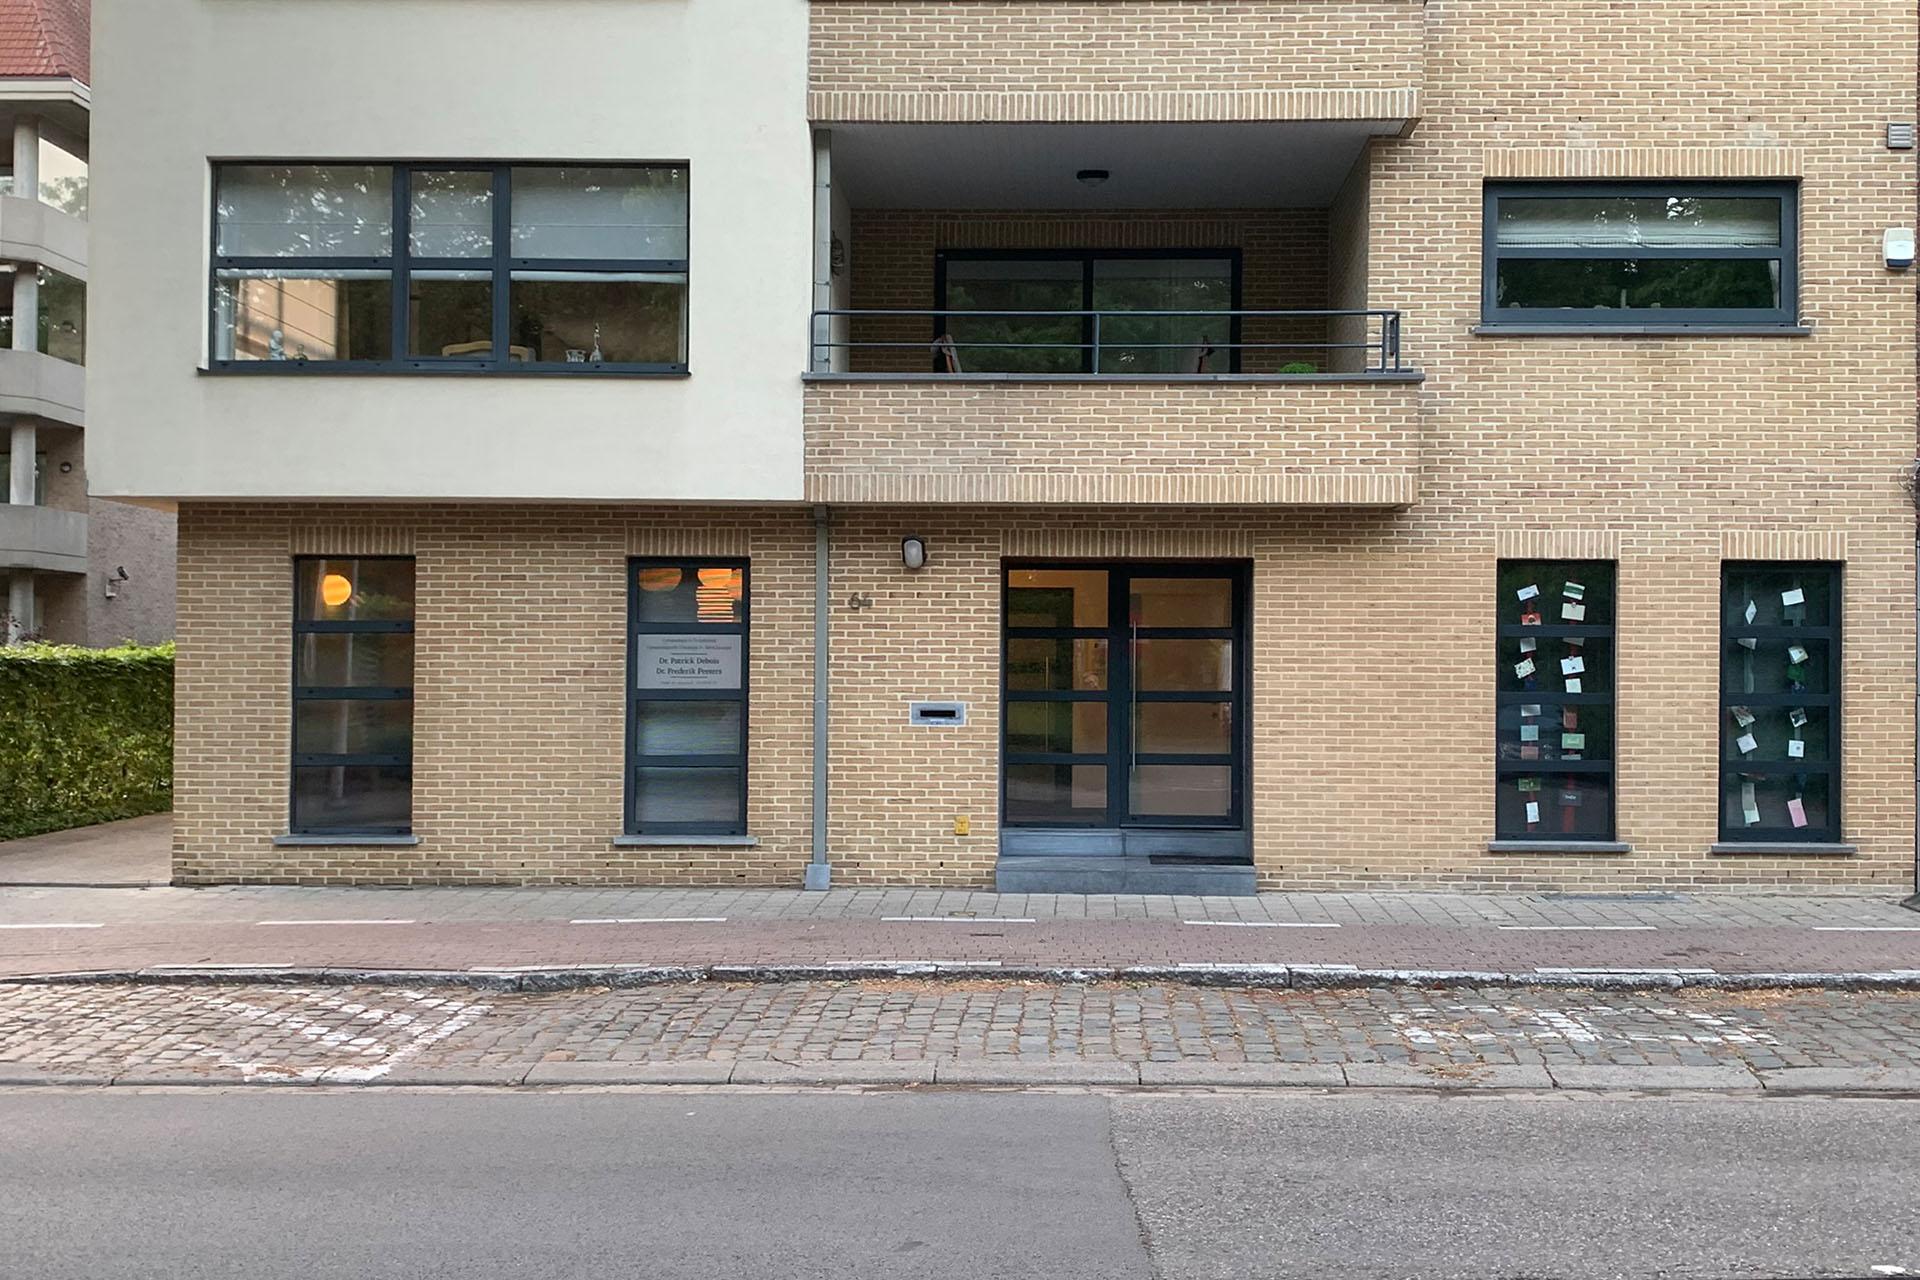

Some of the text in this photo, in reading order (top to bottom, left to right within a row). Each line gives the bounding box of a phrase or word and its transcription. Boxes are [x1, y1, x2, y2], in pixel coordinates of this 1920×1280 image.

[849, 592, 873, 609] 64
[659, 657, 669, 665] Dr.
[670, 656, 695, 665] Patrick
[656, 667, 666, 675] Dr.
[667, 667, 696, 675] Frederik
